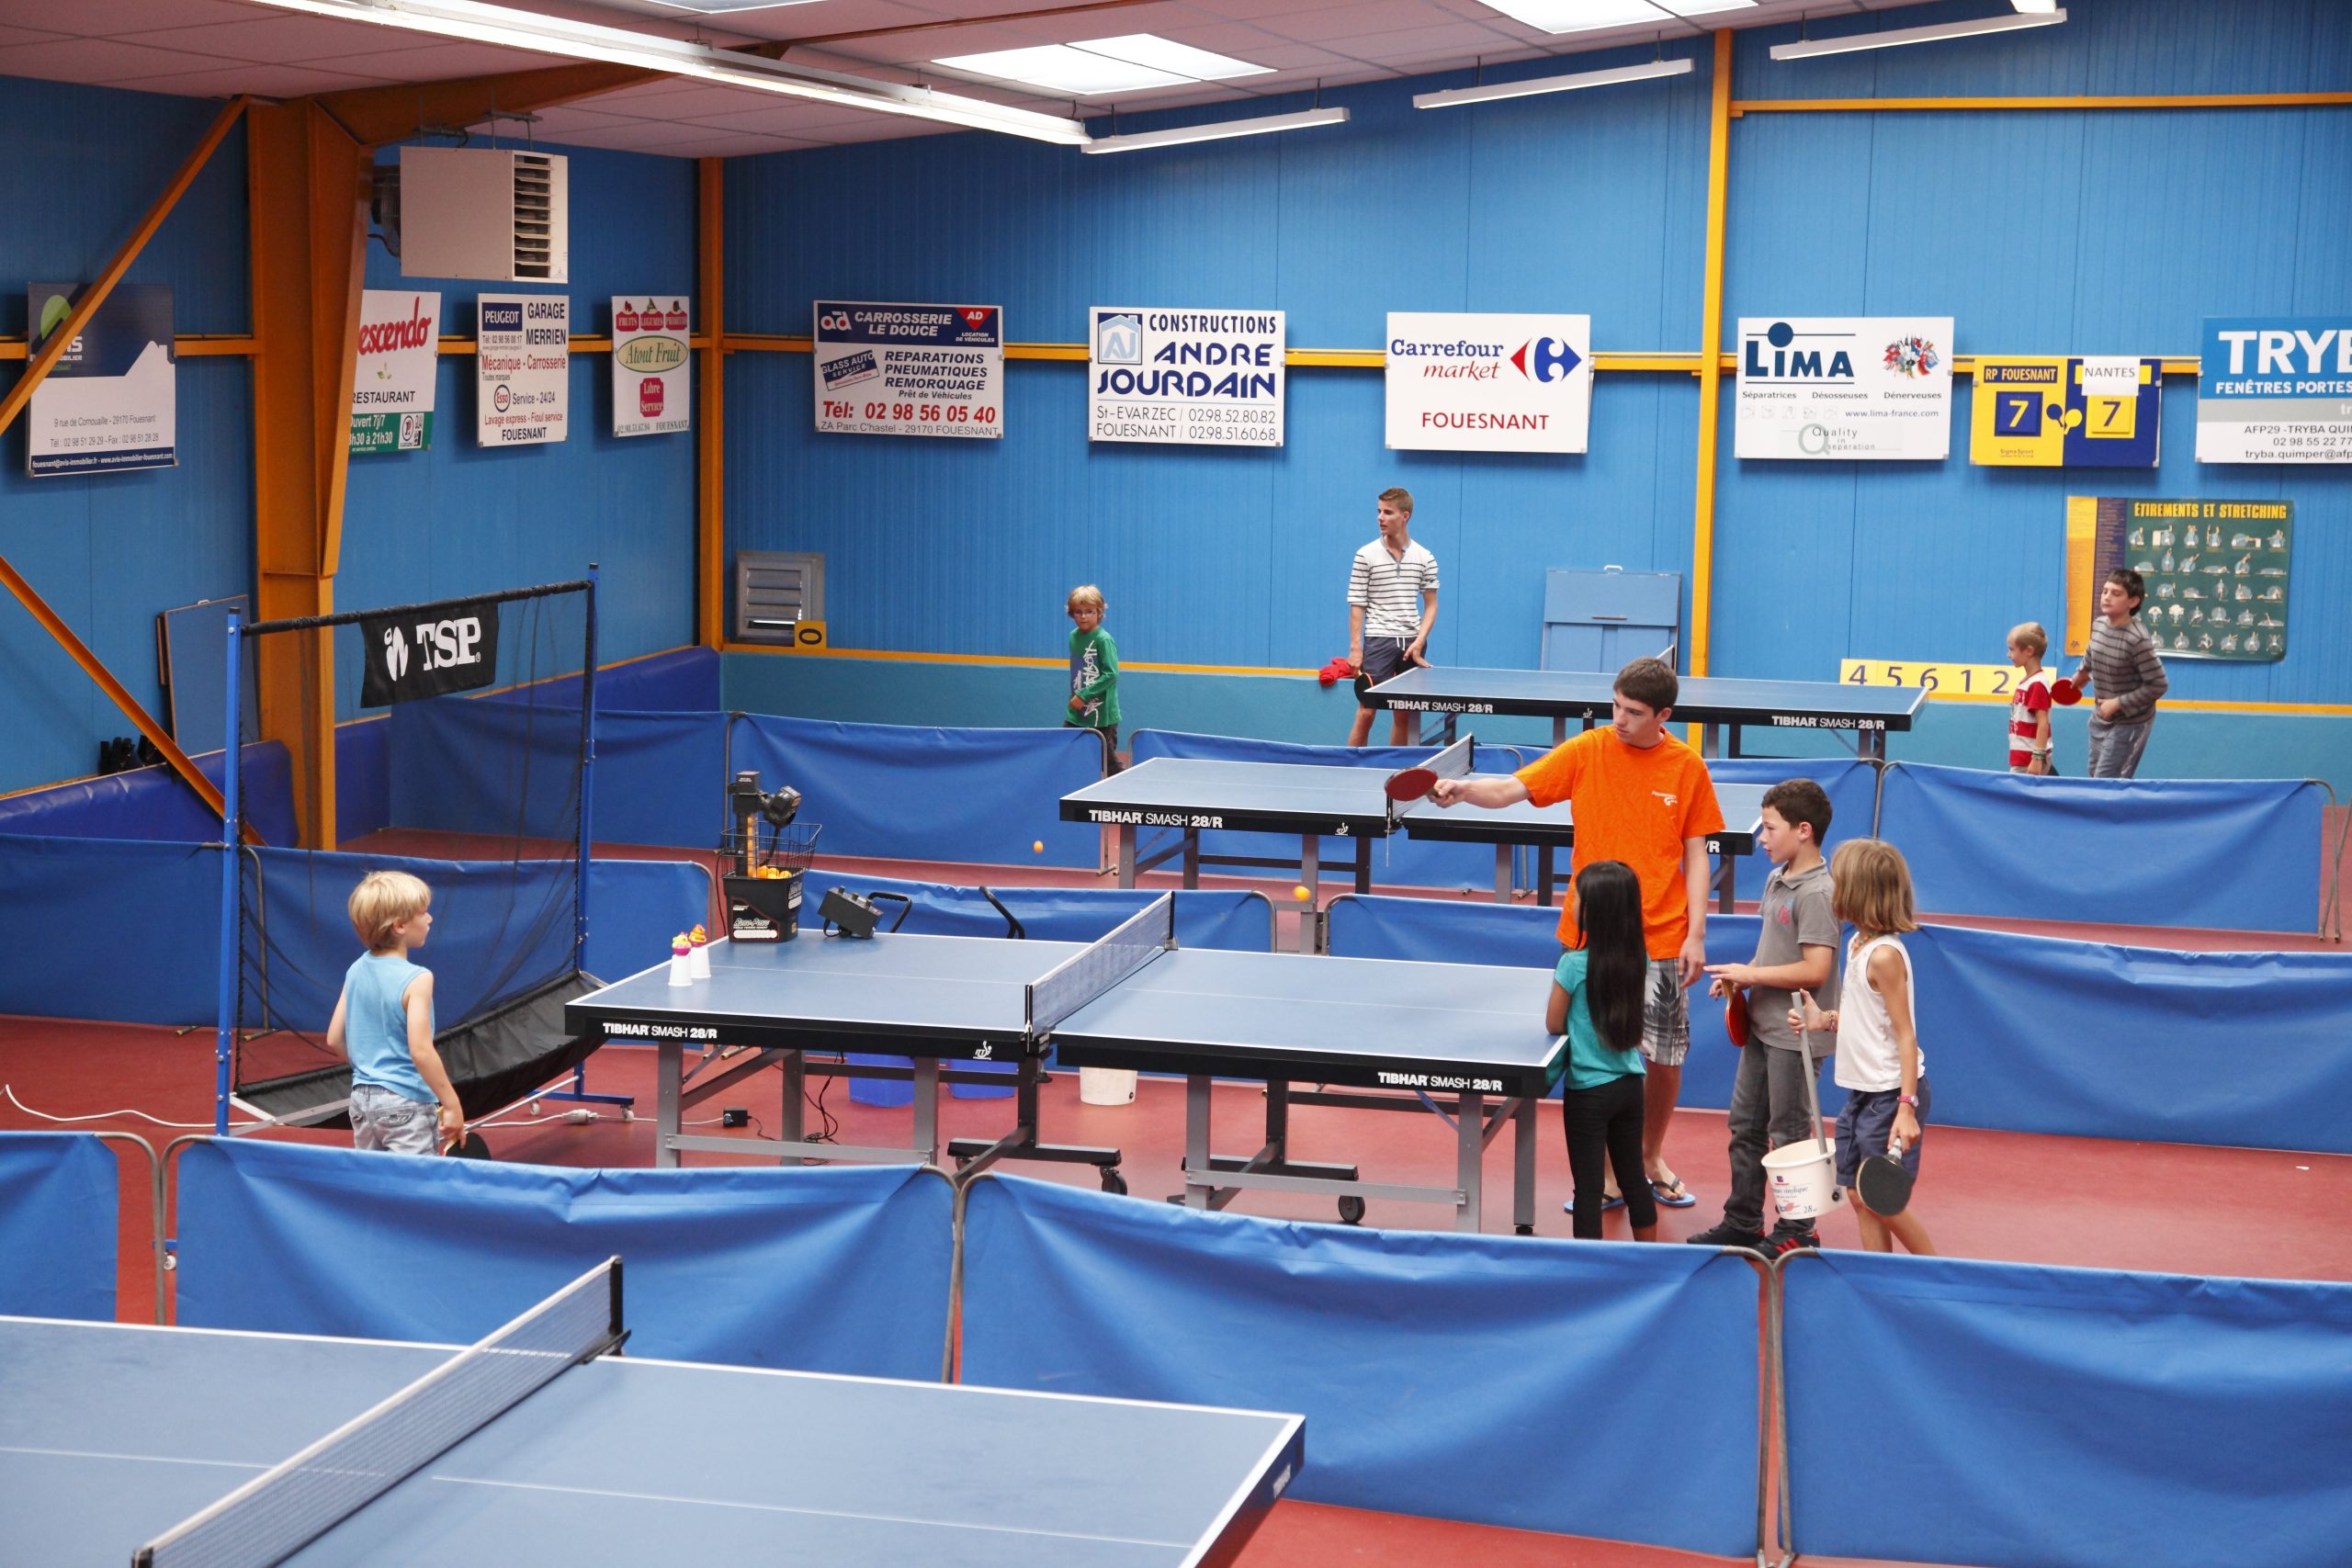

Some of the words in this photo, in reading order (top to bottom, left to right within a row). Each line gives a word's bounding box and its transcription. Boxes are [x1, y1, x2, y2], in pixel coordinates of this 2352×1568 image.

[485, 310, 519, 323] PEUGEOT
[527, 302, 565, 320] GARAGE
[854, 311, 952, 325] CARROSSERIE
[967, 311, 983, 321] AD
[868, 324, 886, 335] LE
[889, 325, 939, 337] DOUCE
[1149, 313, 1276, 334] CONSTRUCTIONS
[526, 329, 566, 345] MERRIEN
[626, 344, 653, 364] Atout
[655, 342, 681, 363] Fruit
[1154, 341, 1275, 367] ANDRE
[1391, 339, 1504, 357] Carrefour
[481, 355, 521, 374] Mécanique
[527, 354, 566, 369] Carrosserie
[822, 359, 850, 374] GLASS
[851, 353, 873, 366] AUTO
[885, 351, 984, 364] REPARATIONS
[832, 363, 865, 377] SERVICE
[885, 364, 988, 378] PNEUMATIQUES
[1423, 360, 1501, 381] market
[1985, 367, 1998, 381] RP
[2002, 367, 2057, 382] FOUESNANT
[2085, 367, 2136, 378] NANTES
[644, 382, 661, 394] Libre
[885, 377, 986, 390] REMORQUAGE
[1097, 368, 1275, 399] JOURDAIN
[2216, 378, 2292, 394] FENÊTRES
[496, 392, 508, 404] Esso
[513, 392, 535, 404] Service
[540, 391, 555, 404] 24/24
[899, 389, 916, 399] Prêt
[932, 390, 972, 400] Véhicules
[1742, 390, 1797, 400] Séparatrices
[1812, 390, 1868, 400] Désosseuses
[1883, 390, 1941, 400] Dénerveuses
[641, 400, 663, 412] Service
[822, 400, 854, 419] Tél:
[865, 402, 887, 420] 02
[892, 403, 913, 421] 98
[919, 404, 941, 422] 56
[946, 405, 968, 423] 05
[974, 406, 996, 423] 40
[2102, 400, 2121, 427] 7
[54, 419, 59, 428] 9
[60, 419, 68, 427] rue
[70, 417, 77, 426] de
[130, 414, 156, 423] Fouesnant
[485, 414, 504, 427] Lavage
[506, 415, 526, 426] express
[545, 412, 563, 423] service
[1422, 412, 1550, 431] FOUESNANT
[1845, 410, 1939, 418] www.lima-france.com
[2008, 400, 2029, 428] 7
[502, 427, 547, 441] FOUESNANT
[820, 422, 834, 430] ZA
[837, 422, 857, 432] Parc
[860, 423, 897, 433] C'hastel
[904, 424, 933, 434] 29170
[936, 425, 998, 436] FOUESNANT
[1096, 423, 1176, 439] FOUESNANT
[1813, 426, 1858, 439] Quality
[2244, 425, 2280, 434] AFP29
[2328, 425, 2352, 434] QUI
[366, 433, 371, 445] à
[372, 432, 393, 445] 21h30
[2273, 437, 2287, 446] 02
[2290, 437, 2303, 446] 98
[2306, 437, 2320, 446] 55
[2323, 437, 2336, 446] 22
[2134, 502, 2199, 518] ÉTIREMENTS
[2203, 503, 2215, 517] ET
[2219, 503, 2287, 519] STRETCHING
[416, 617, 481, 671] TSP
[1849, 665, 1868, 685] 4
[1887, 666, 1903, 687] 5
[1920, 668, 1939, 692] 6
[1961, 670, 1972, 693] 1
[1992, 671, 2009, 694] 2
[1387, 699, 1430, 711] TIBHAR
[1431, 702, 1465, 712] SMASH
[1467, 703, 1493, 714] 28/R
[1771, 716, 1817, 728] TIBHAR
[1819, 717, 1856, 728] SMASH
[1858, 719, 1885, 730] 28/R
[1089, 809, 1143, 824] TIBHAR
[1145, 813, 1188, 826] SMASH
[1191, 815, 1223, 829] 28/R
[603, 1022, 650, 1036] TIBHAR
[651, 1025, 688, 1038] SMASH
[690, 1027, 718, 1039] 28/R
[1378, 1071, 1429, 1087] TIBHAR
[1430, 1075, 1470, 1089] SMASH
[1473, 1078, 1503, 1091] 28/R
